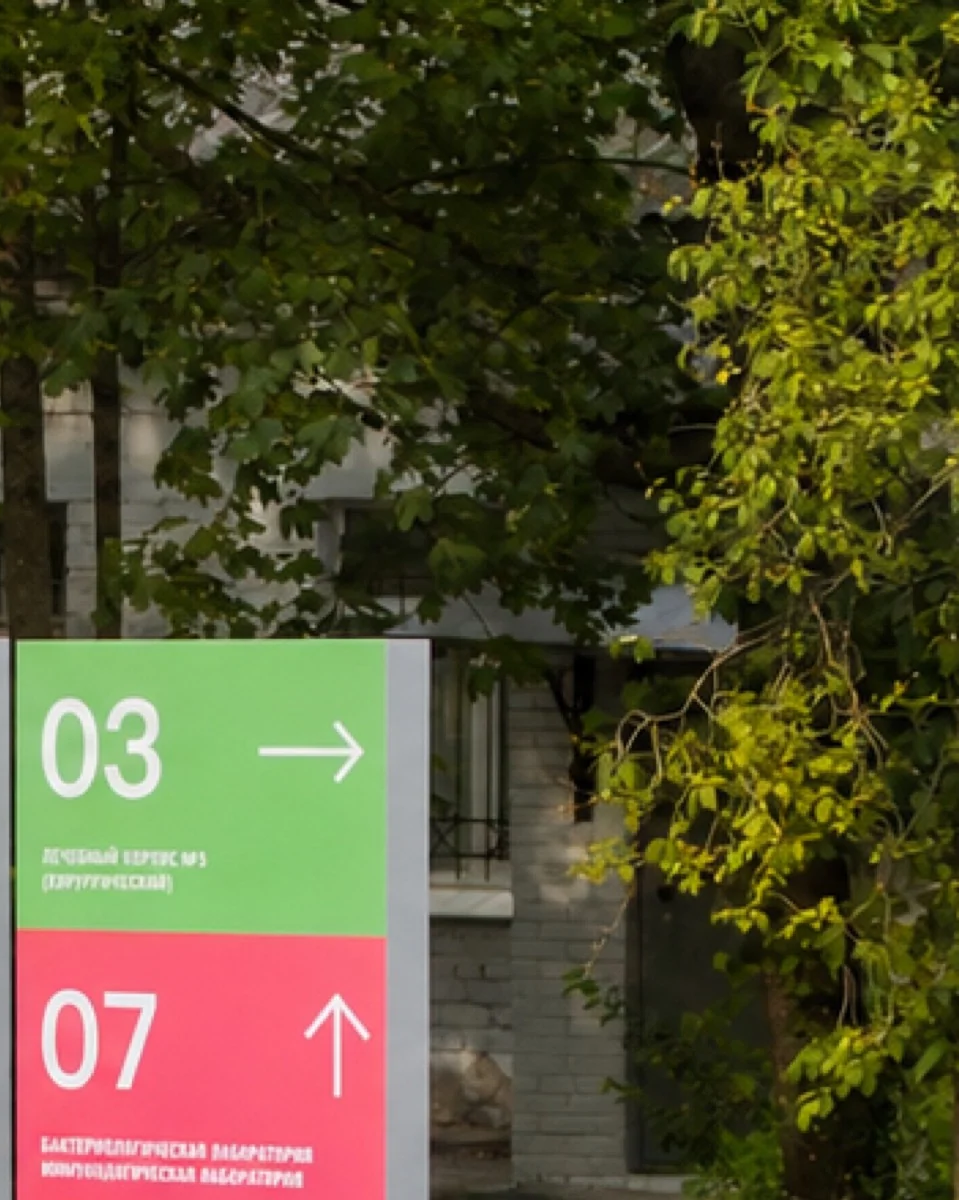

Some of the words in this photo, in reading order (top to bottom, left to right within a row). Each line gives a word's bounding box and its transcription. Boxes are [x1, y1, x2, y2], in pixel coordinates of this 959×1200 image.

[42, 697, 161, 799] 03
[42, 989, 157, 1090] 07
[200, 1167, 304, 1188] ЛАБОРАТОРИЯ
[211, 1143, 313, 1164] ЛАБОРАТОРИЯ
